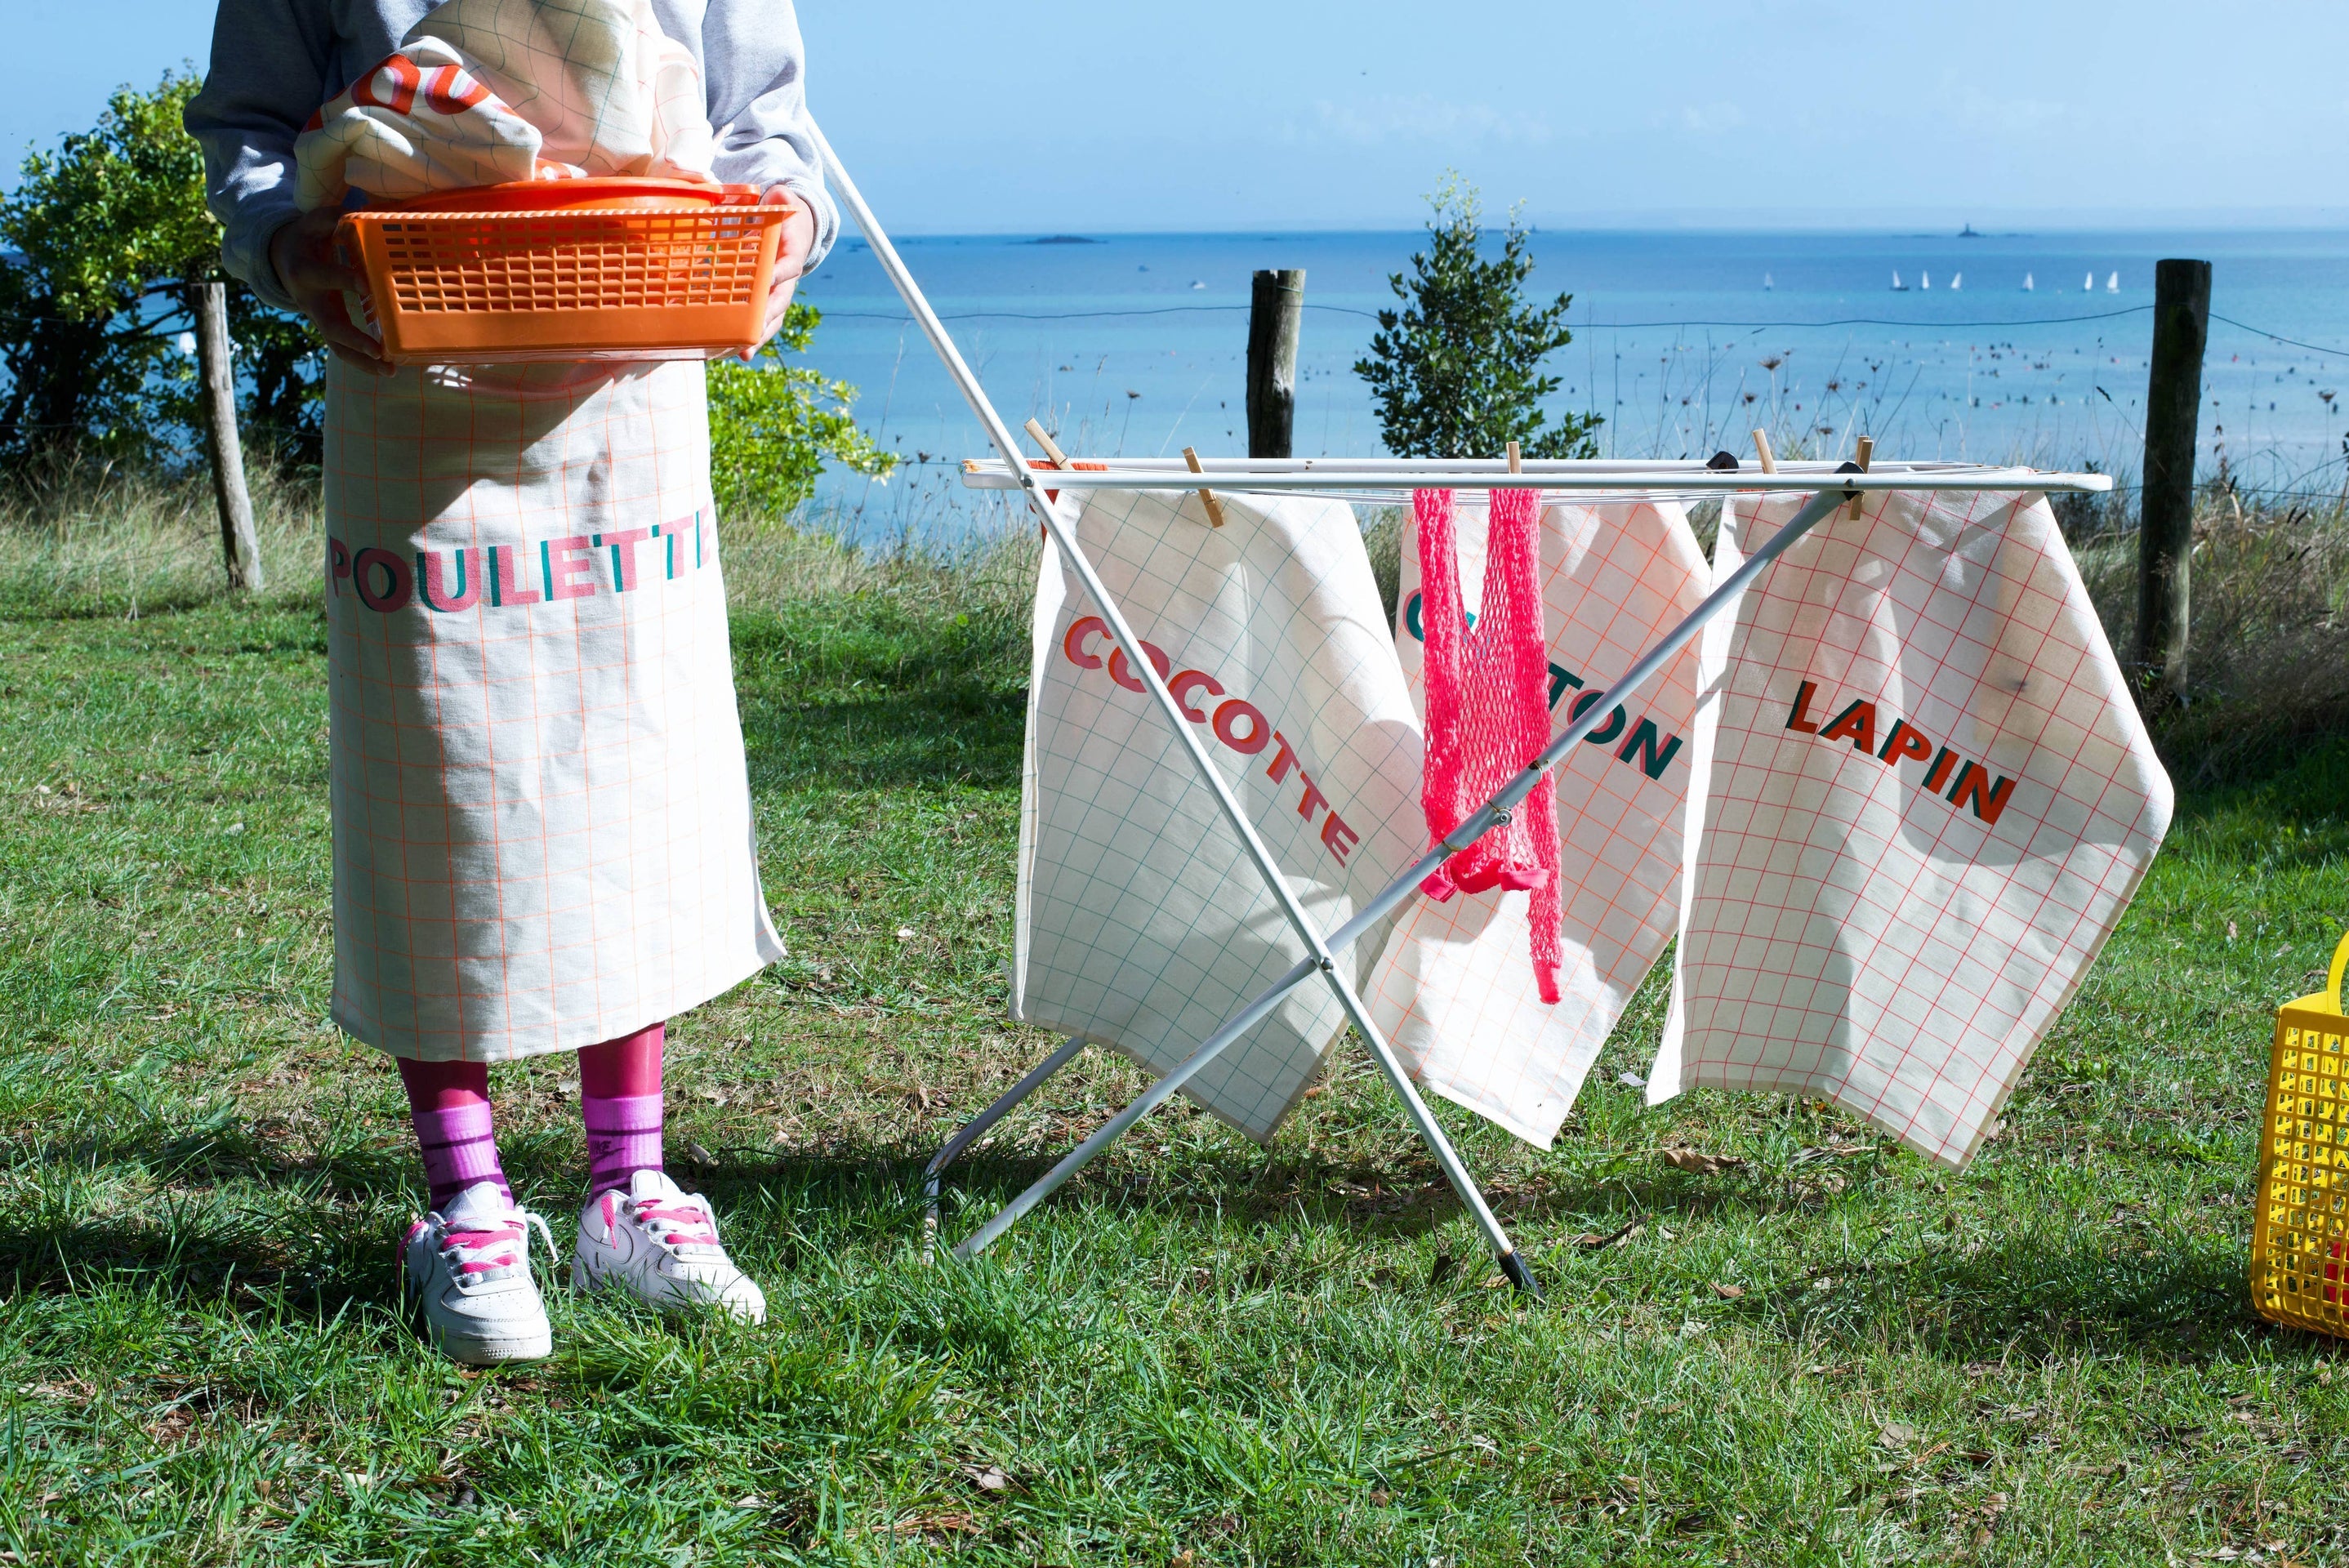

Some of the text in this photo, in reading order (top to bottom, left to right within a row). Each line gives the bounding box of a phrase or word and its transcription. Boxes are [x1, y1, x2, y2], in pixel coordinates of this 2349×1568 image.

[329, 501, 711, 613] POULETTE
[1063, 616, 1360, 869] COCOTTE
[1785, 679, 2017, 826] LAPIN
